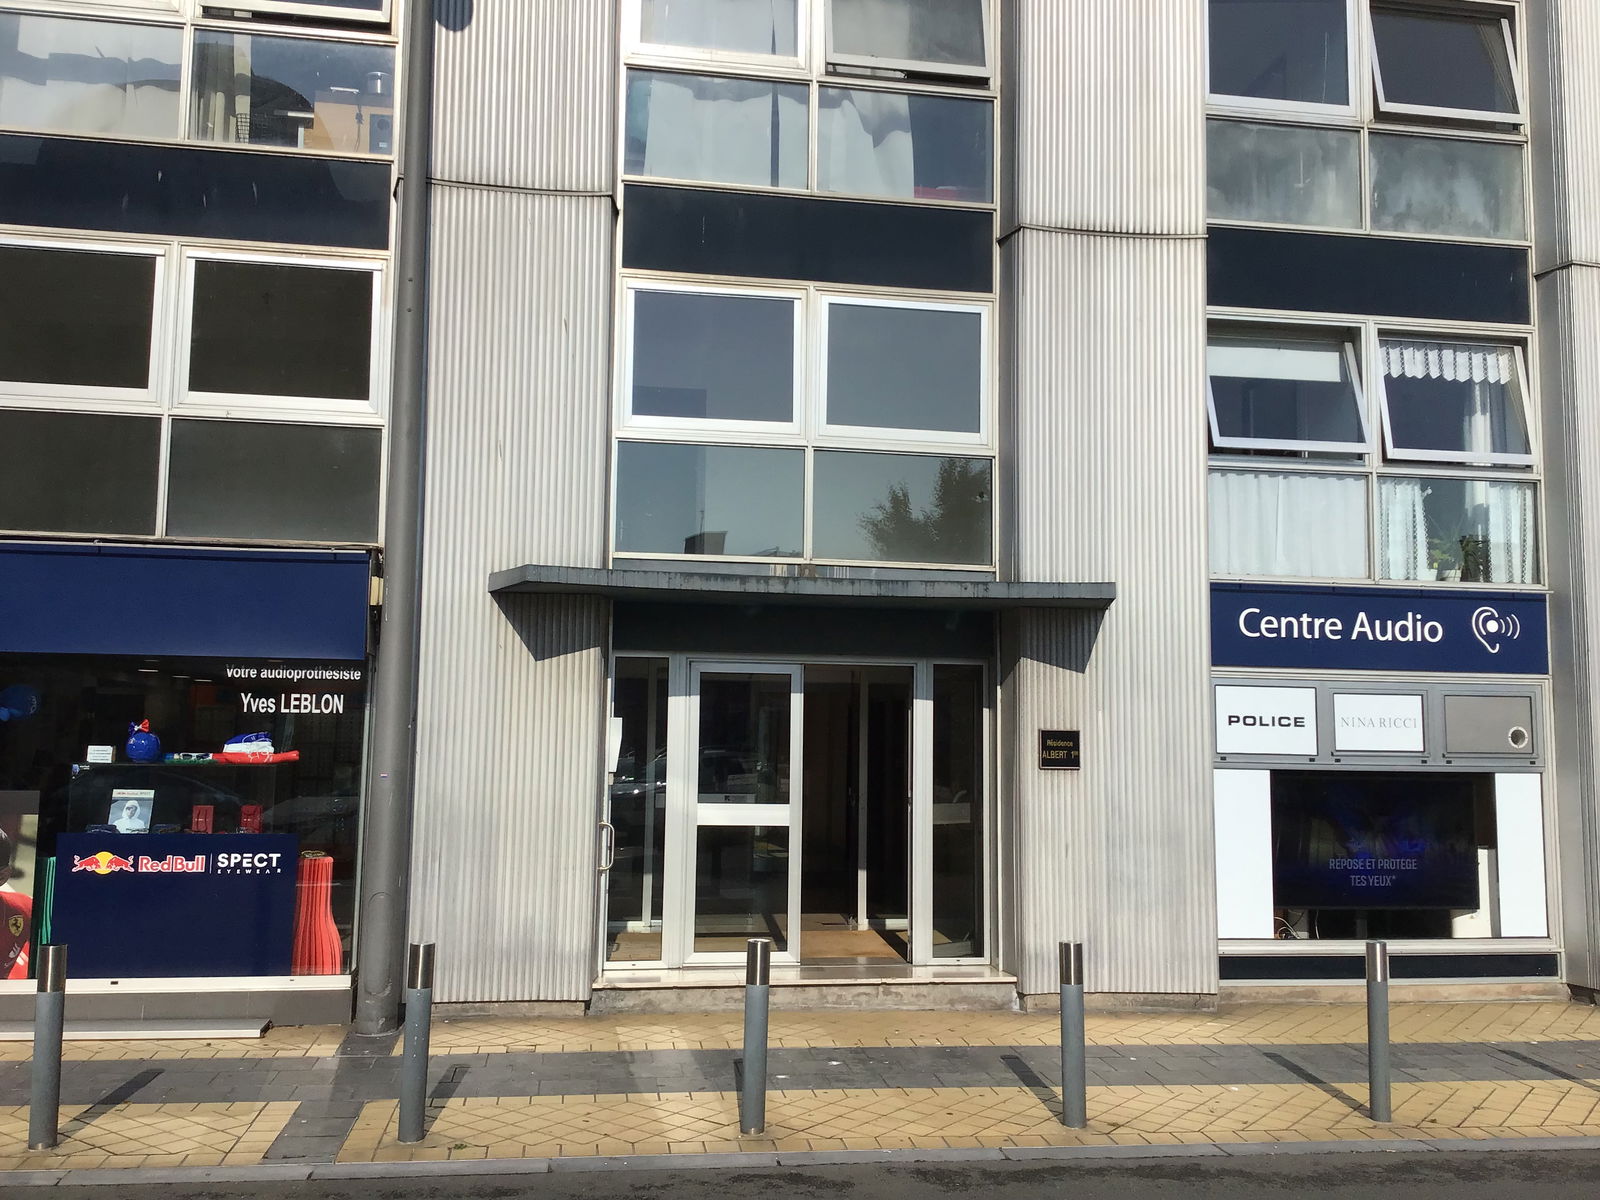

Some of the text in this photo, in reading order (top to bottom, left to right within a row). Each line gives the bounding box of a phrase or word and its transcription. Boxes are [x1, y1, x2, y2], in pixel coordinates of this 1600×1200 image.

[1238, 607, 1444, 643] Centre Audio
[241, 692, 344, 714] Yves LEBLON
[1228, 715, 1305, 728] POLICE
[1042, 750, 1068, 759] ALBERT
[217, 853, 281, 868] SPECT
[1329, 858, 1364, 870] REPOSE
[1366, 858, 1376, 870] ET
[1350, 875, 1367, 887] TES
